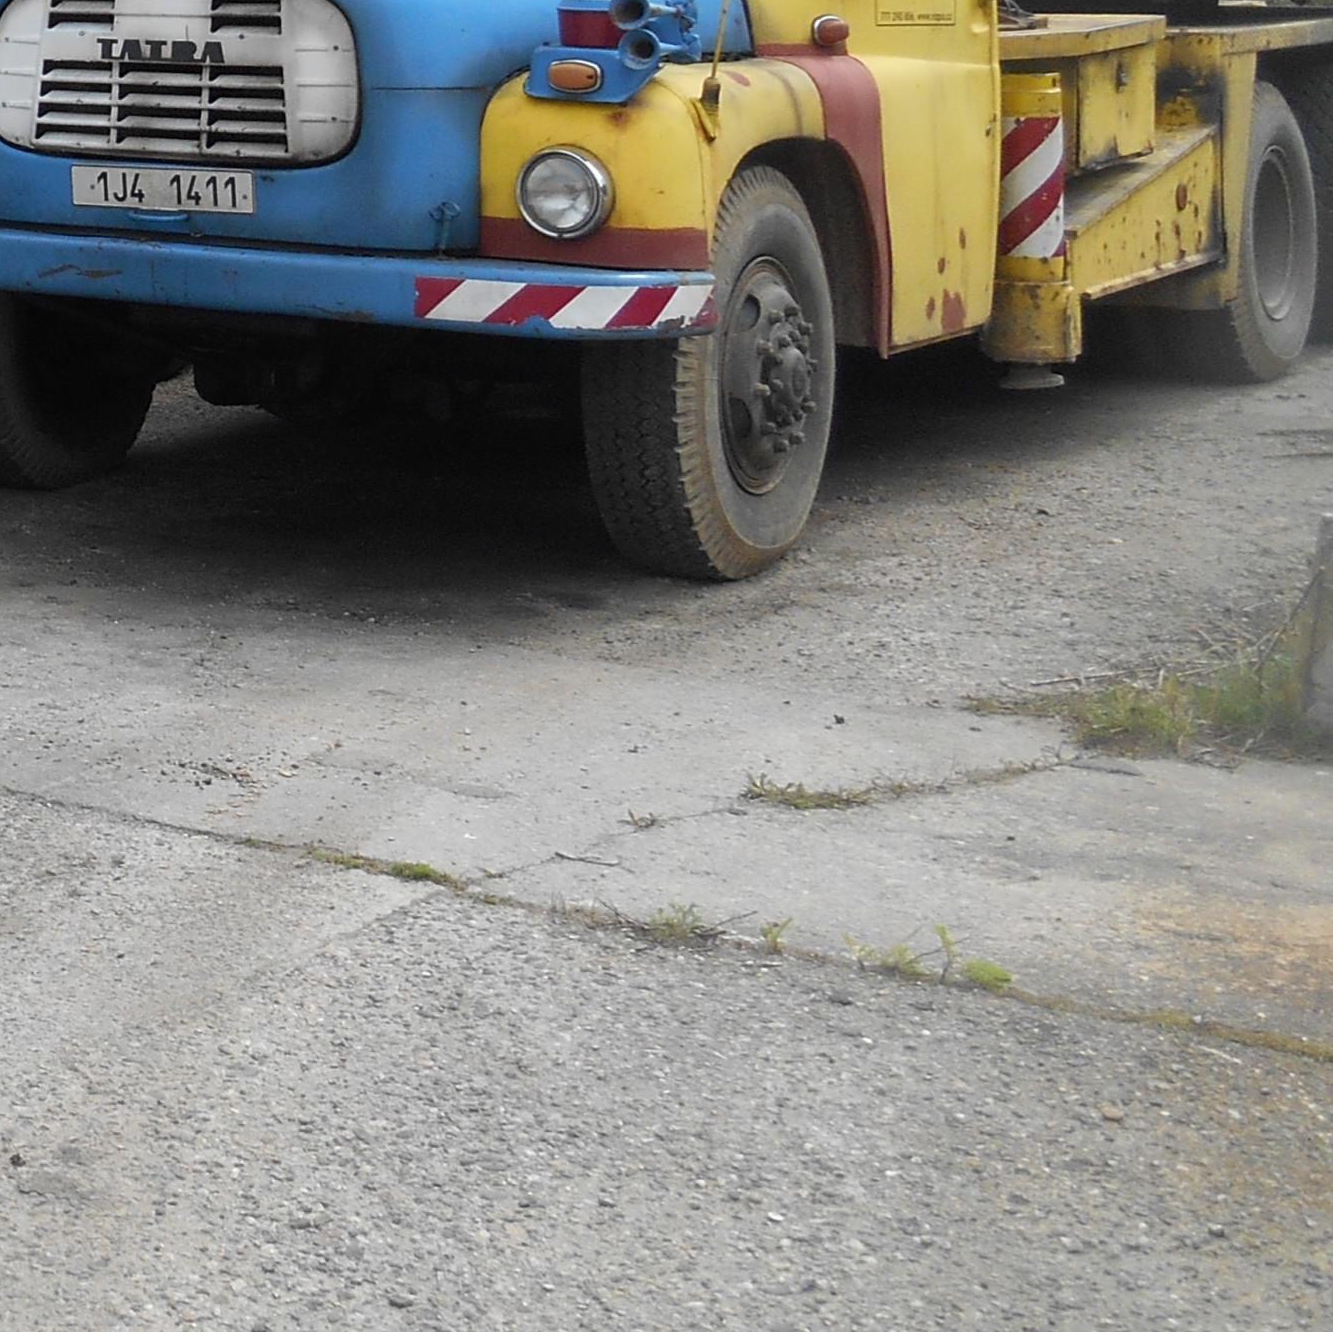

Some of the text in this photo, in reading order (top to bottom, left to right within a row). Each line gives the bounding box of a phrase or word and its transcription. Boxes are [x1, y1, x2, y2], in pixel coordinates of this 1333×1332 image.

[96, 38, 225, 64] TATRA
[96, 171, 238, 209] 1J4 1411
